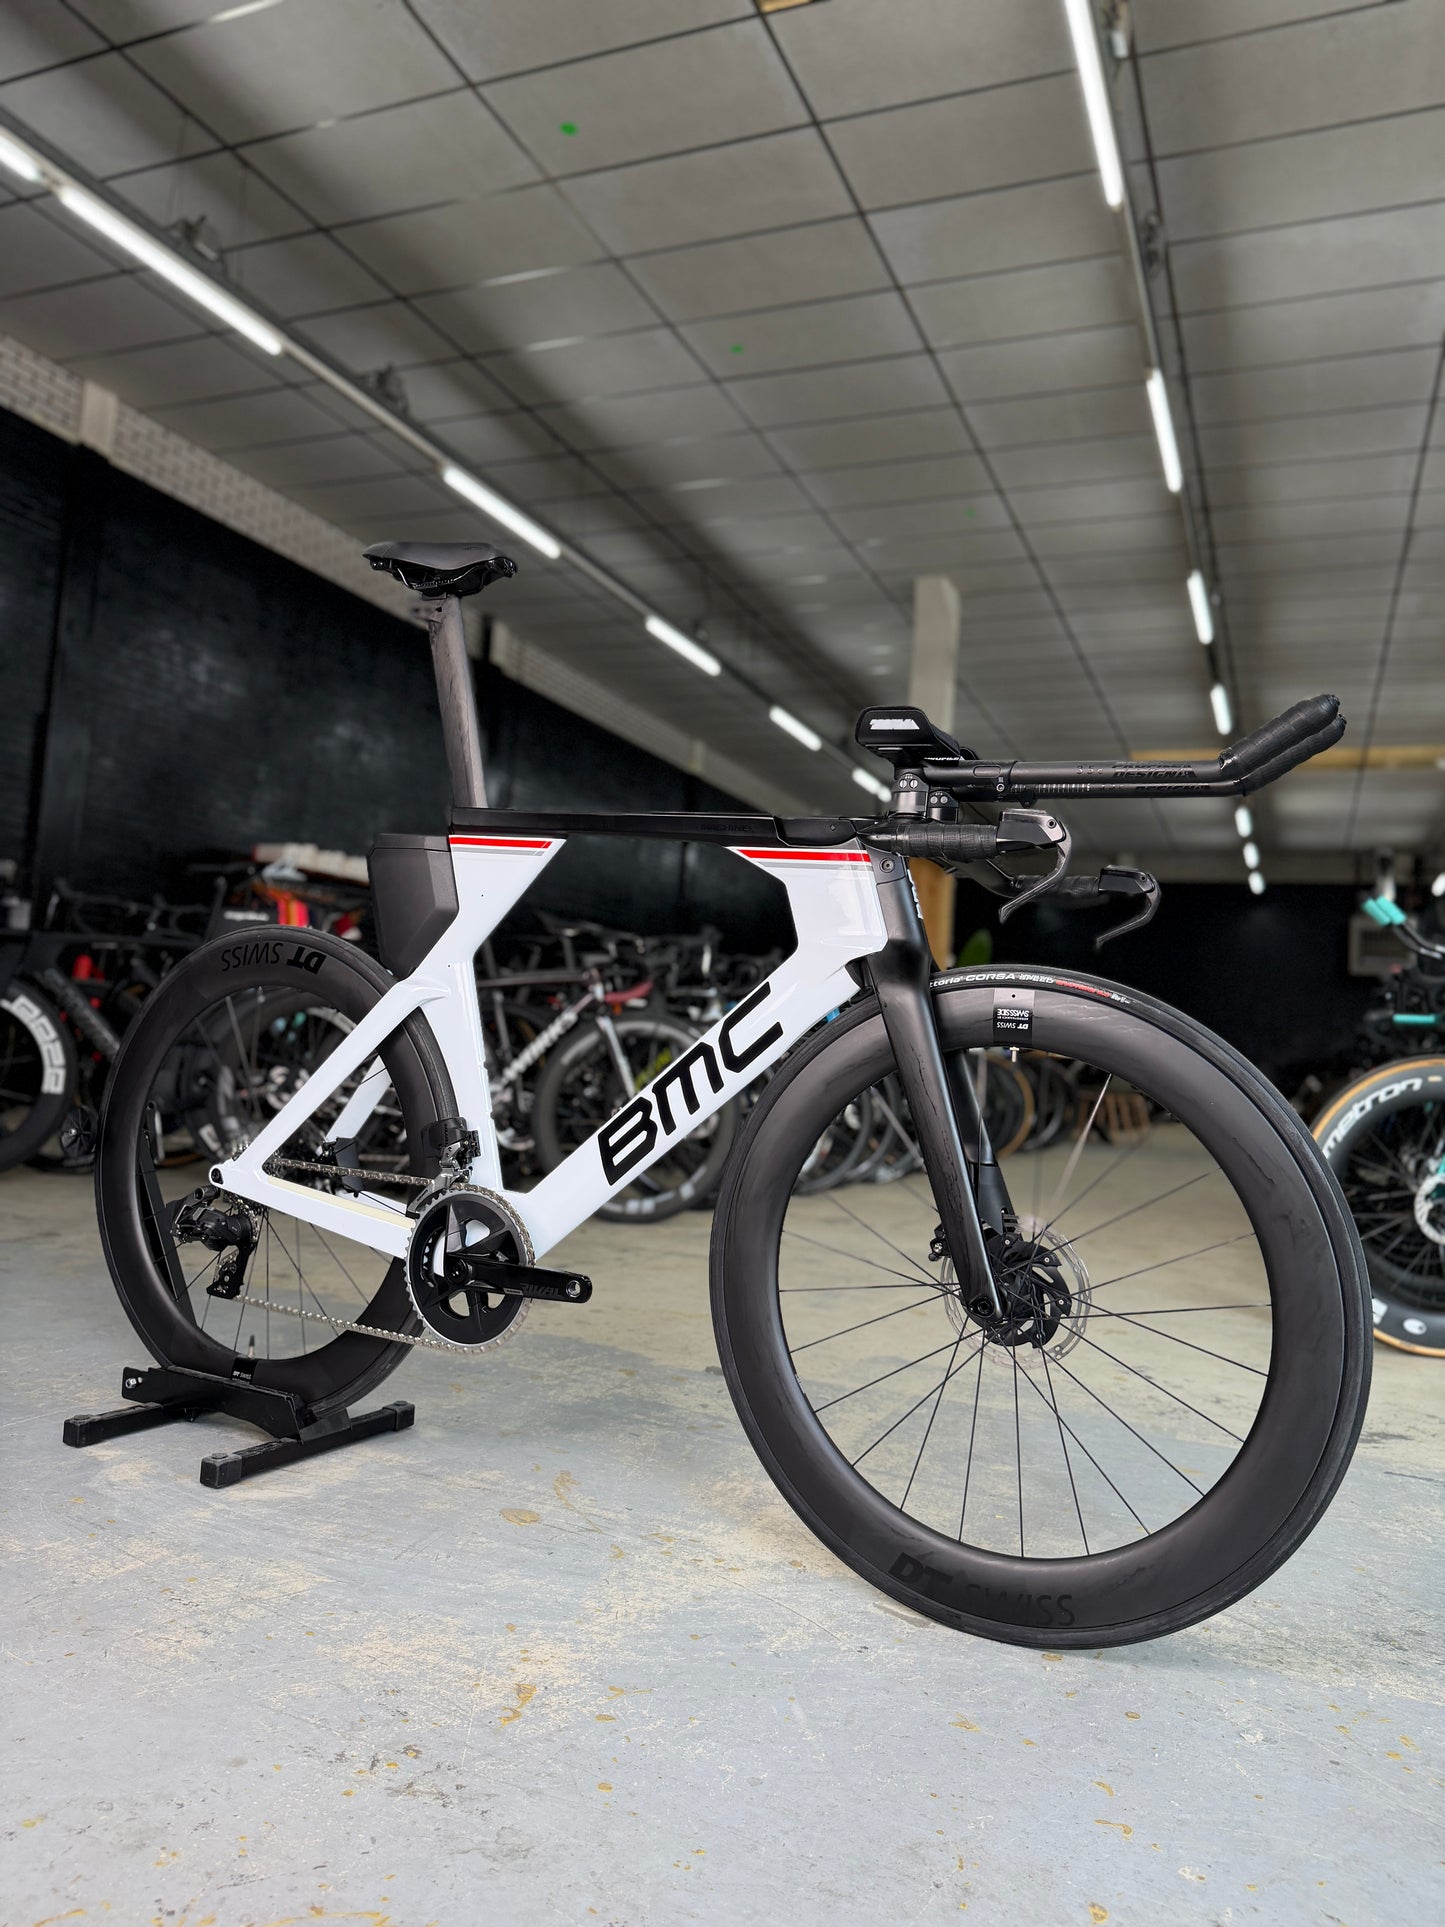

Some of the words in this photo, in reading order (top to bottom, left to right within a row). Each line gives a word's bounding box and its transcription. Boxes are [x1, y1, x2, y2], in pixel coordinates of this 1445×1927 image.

[221, 942, 284, 972] SWISS
[286, 945, 328, 975] DT
[929, 976, 961, 988] ttoria
[965, 973, 1015, 982] CORSA
[598, 981, 784, 1186] BMC
[1322, 1078, 1423, 1160] metron
